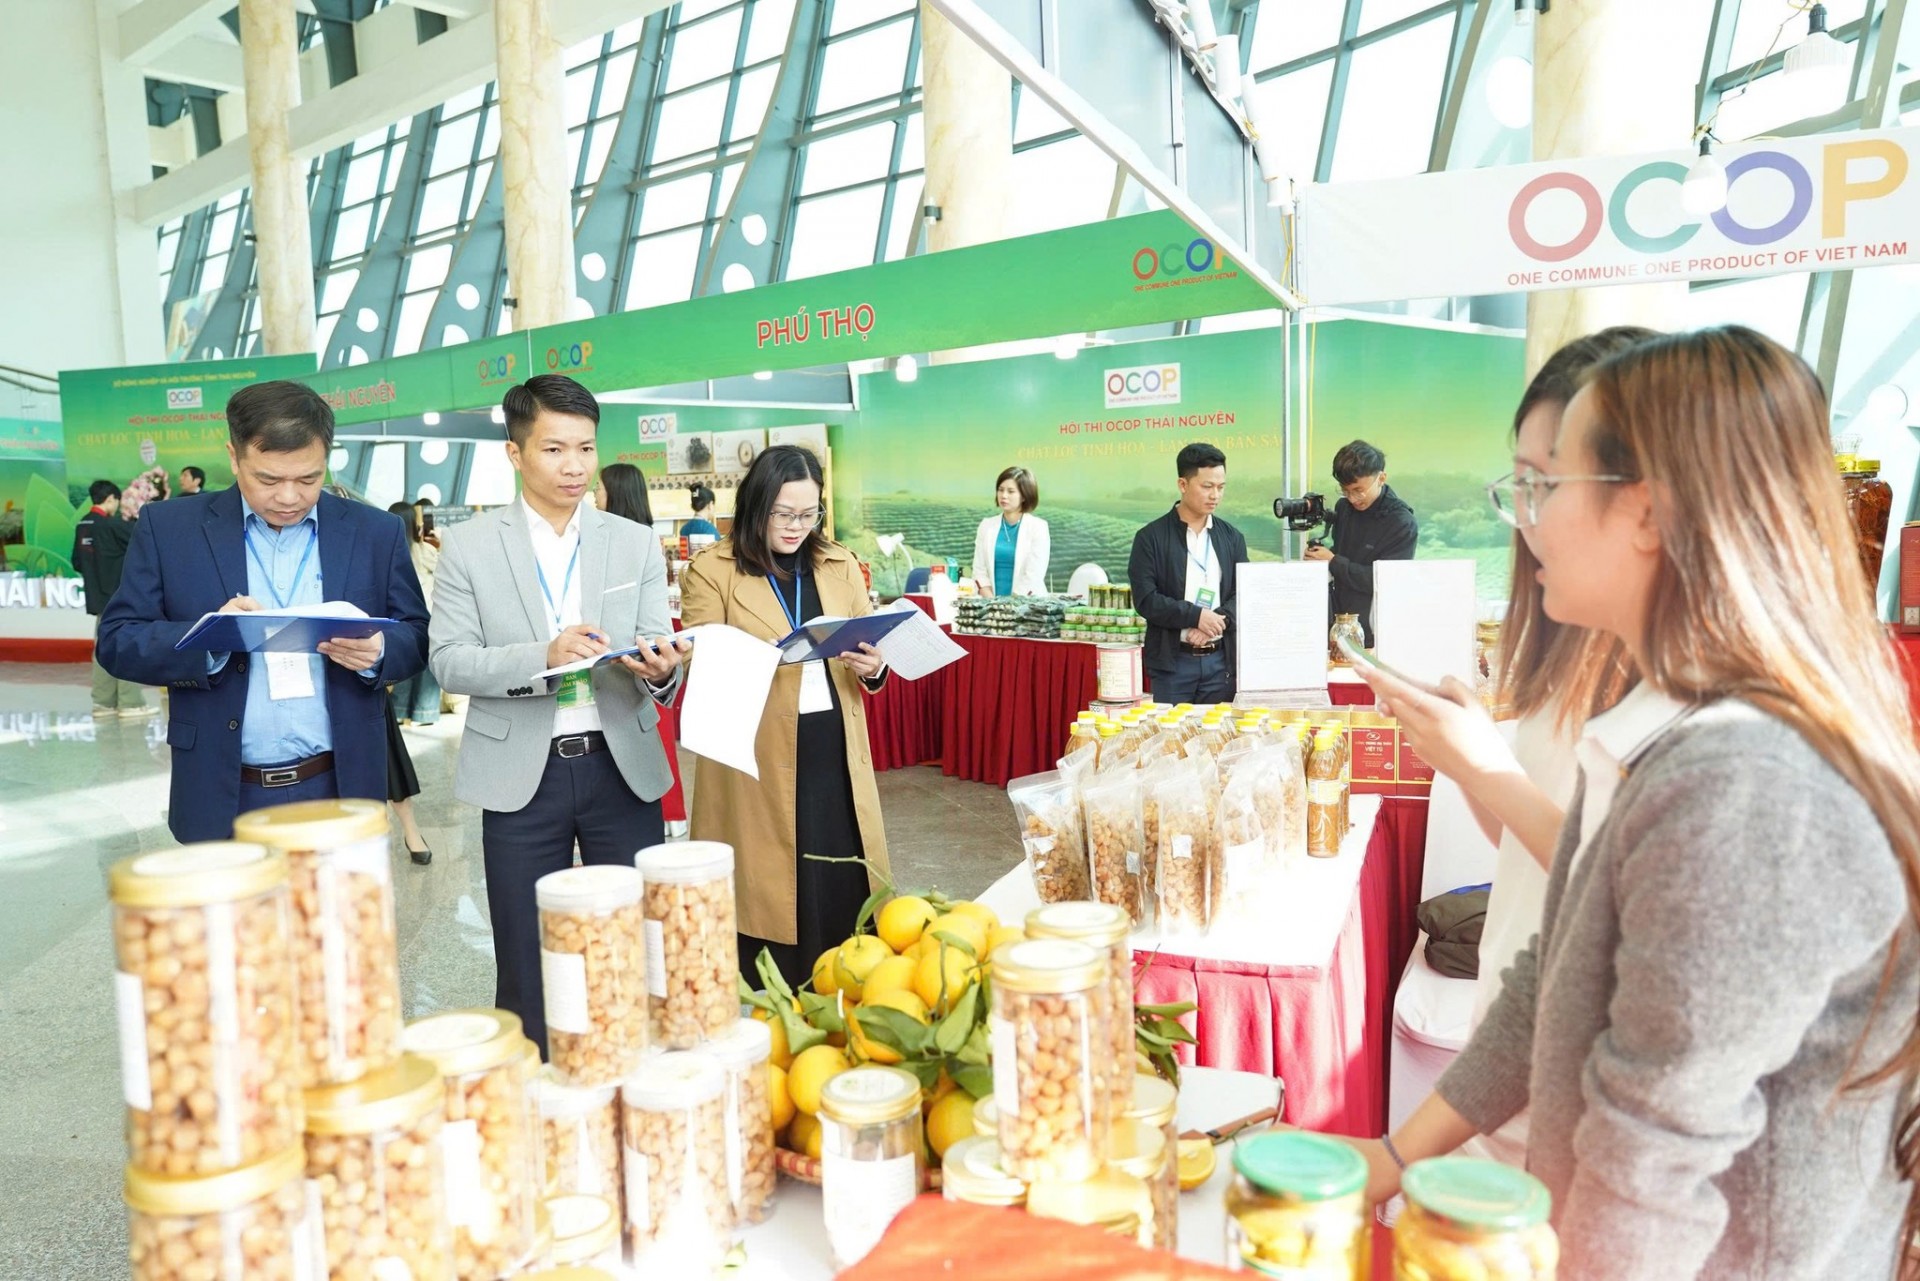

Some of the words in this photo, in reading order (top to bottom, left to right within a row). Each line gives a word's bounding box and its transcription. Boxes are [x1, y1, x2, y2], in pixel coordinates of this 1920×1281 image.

[1508, 140, 1908, 262] OCOP
[1507, 271, 1542, 286] ONE
[1549, 264, 1638, 283] COMMUNE
[1645, 260, 1681, 275] ONE
[1688, 253, 1778, 272] PRODUCT
[1784, 250, 1809, 265] OF
[1815, 246, 1858, 261] VIET
[1864, 242, 1908, 257] NAM
[757, 306, 810, 348] PHÚ
[816, 303, 876, 341] THỌ
[479, 353, 516, 380] OCOP
[546, 341, 593, 370] OCOP
[348, 379, 396, 409] NGUYÊN
[1107, 367, 1178, 396] OCOP
[168, 390, 199, 403] OCOP
[640, 416, 674, 435] OCOP
[1060, 421, 1081, 435] HỘI
[1084, 421, 1103, 433] THI
[1105, 418, 1141, 432] OCOP
[1144, 414, 1175, 430] THÁI
[1178, 410, 1236, 427] NGUYÊN
[640, 451, 658, 461] OCOP
